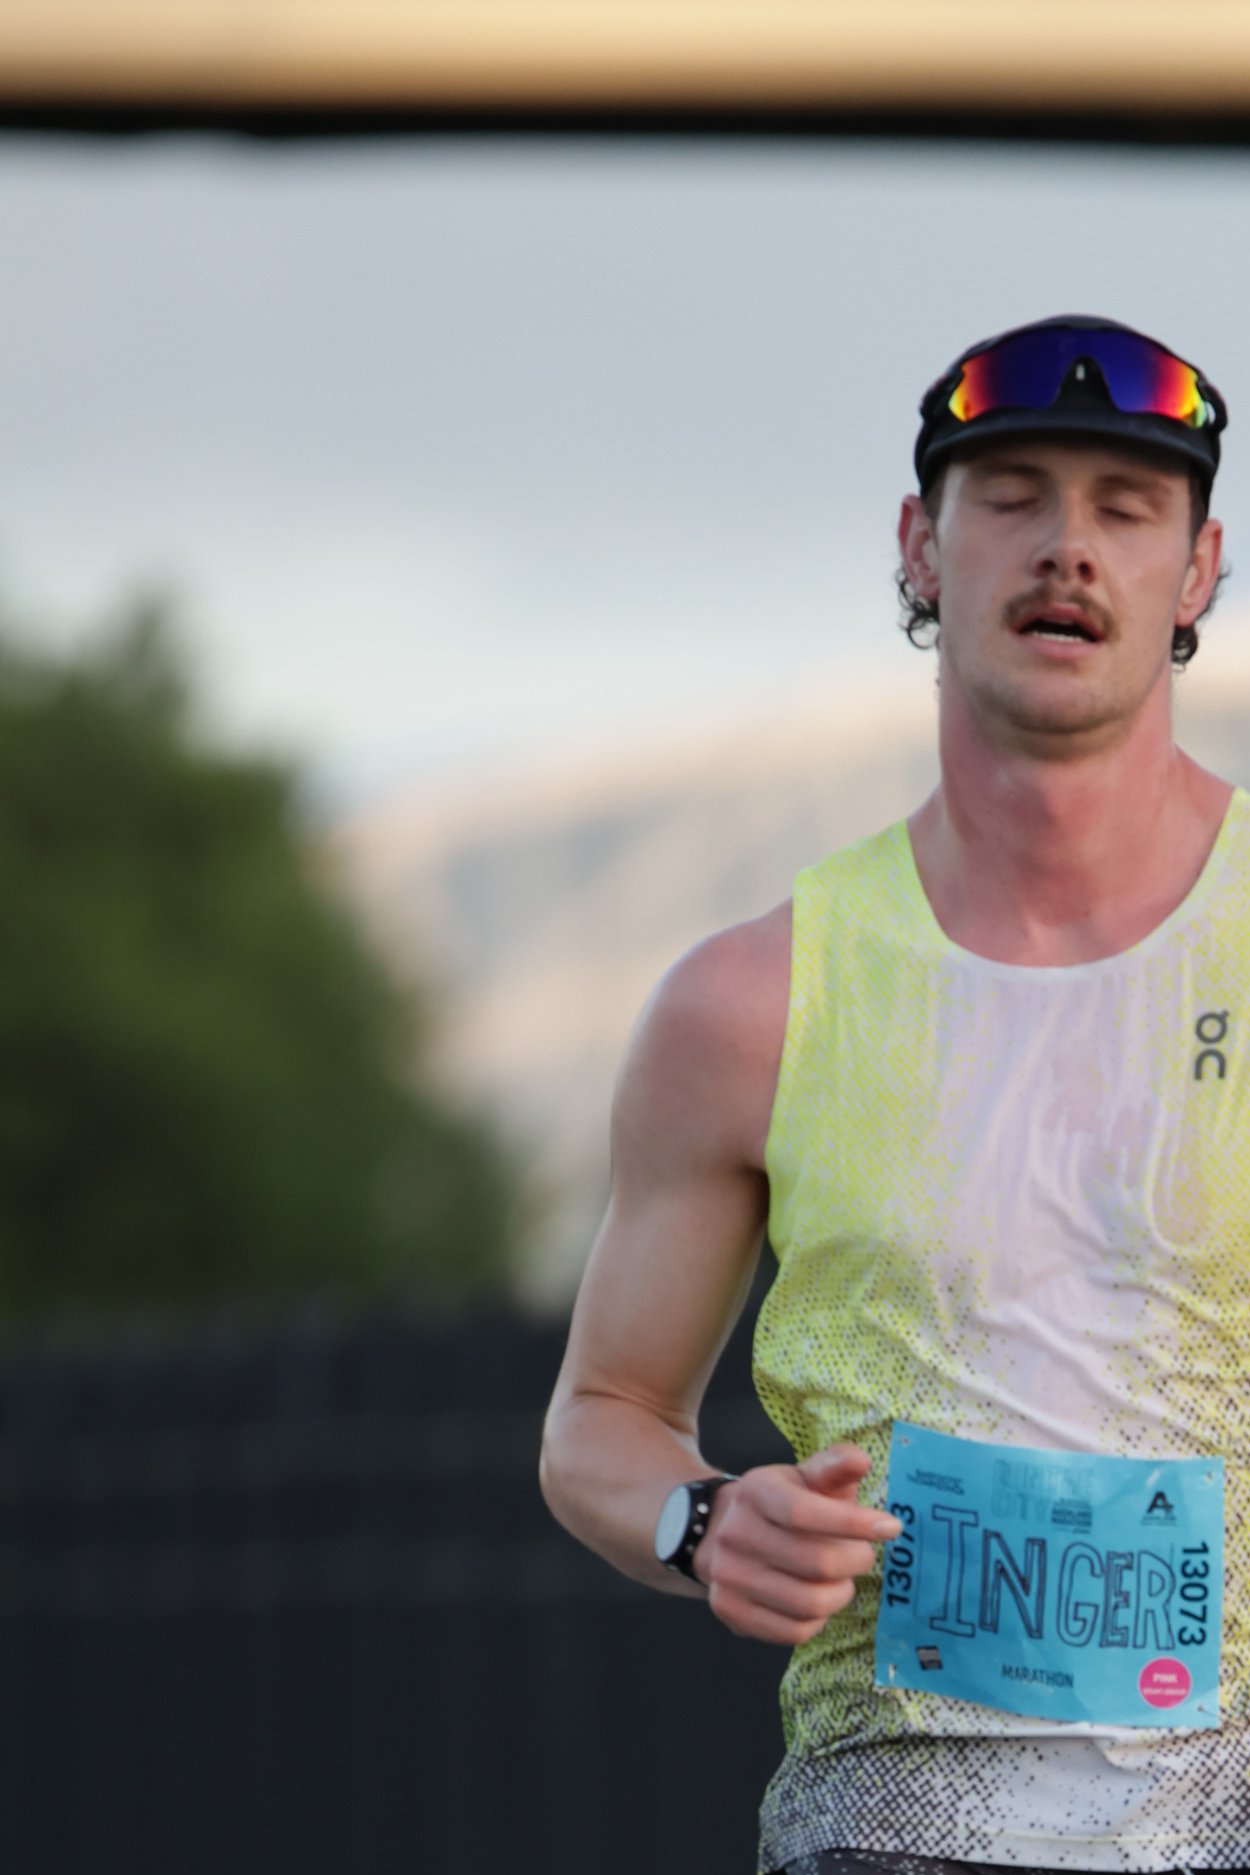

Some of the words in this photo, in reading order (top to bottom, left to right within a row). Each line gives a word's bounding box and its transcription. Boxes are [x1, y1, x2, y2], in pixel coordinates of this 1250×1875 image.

[929, 1503, 1177, 1652] INGER
[1178, 1541, 1211, 1647] 13073
[1001, 1663, 1075, 1689] MARATHON
